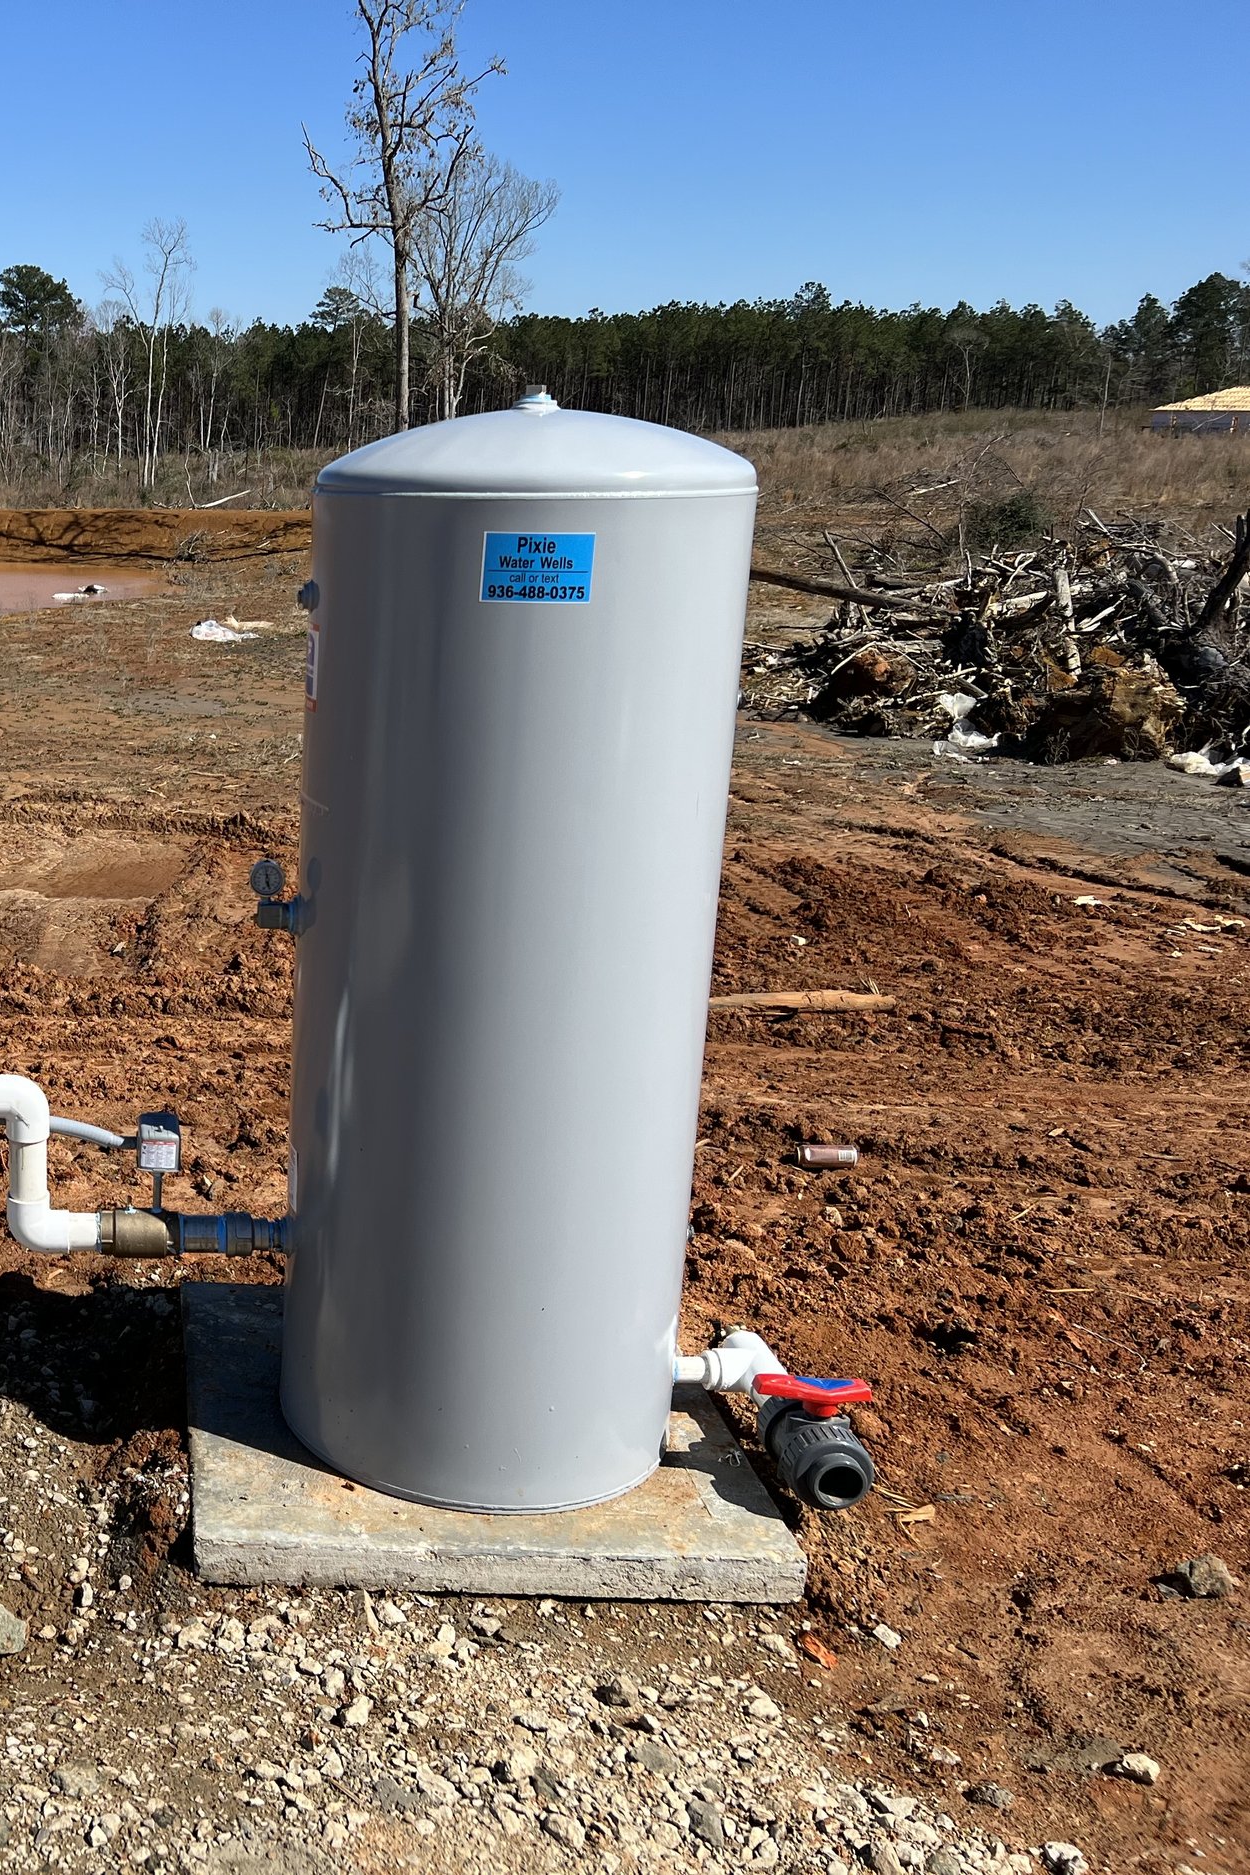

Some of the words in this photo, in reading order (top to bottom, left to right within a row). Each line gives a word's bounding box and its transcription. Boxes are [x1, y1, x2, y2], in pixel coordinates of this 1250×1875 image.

[517, 536, 556, 554] Pixie
[499, 555, 535, 569] Water
[540, 556, 574, 569] Wells
[509, 572, 526, 583] call
[528, 575, 539, 583] or
[541, 574, 559, 584] text
[487, 585, 585, 599] 936-488-0375
